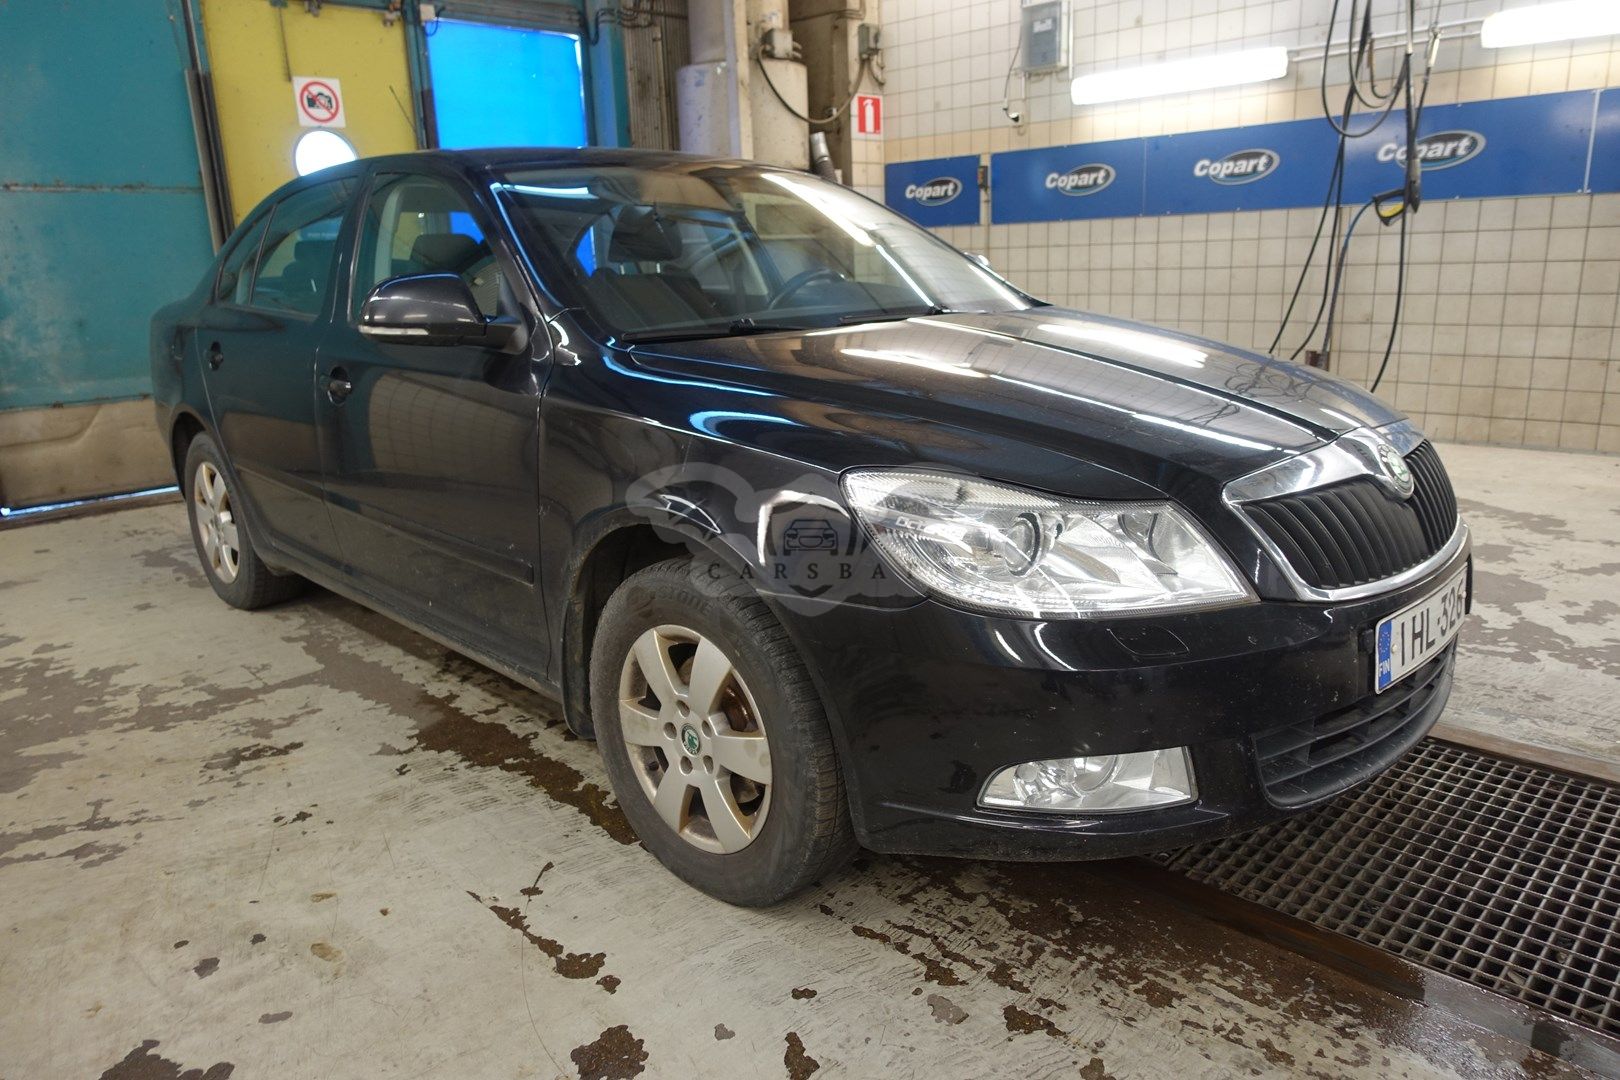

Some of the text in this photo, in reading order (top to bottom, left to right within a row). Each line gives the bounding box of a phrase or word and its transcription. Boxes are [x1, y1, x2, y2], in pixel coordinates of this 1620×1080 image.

[1193, 154, 1269, 178] Copart
[1045, 169, 1106, 191] Copart
[905, 182, 955, 200] Copart
[1378, 658, 1391, 678] FIN
